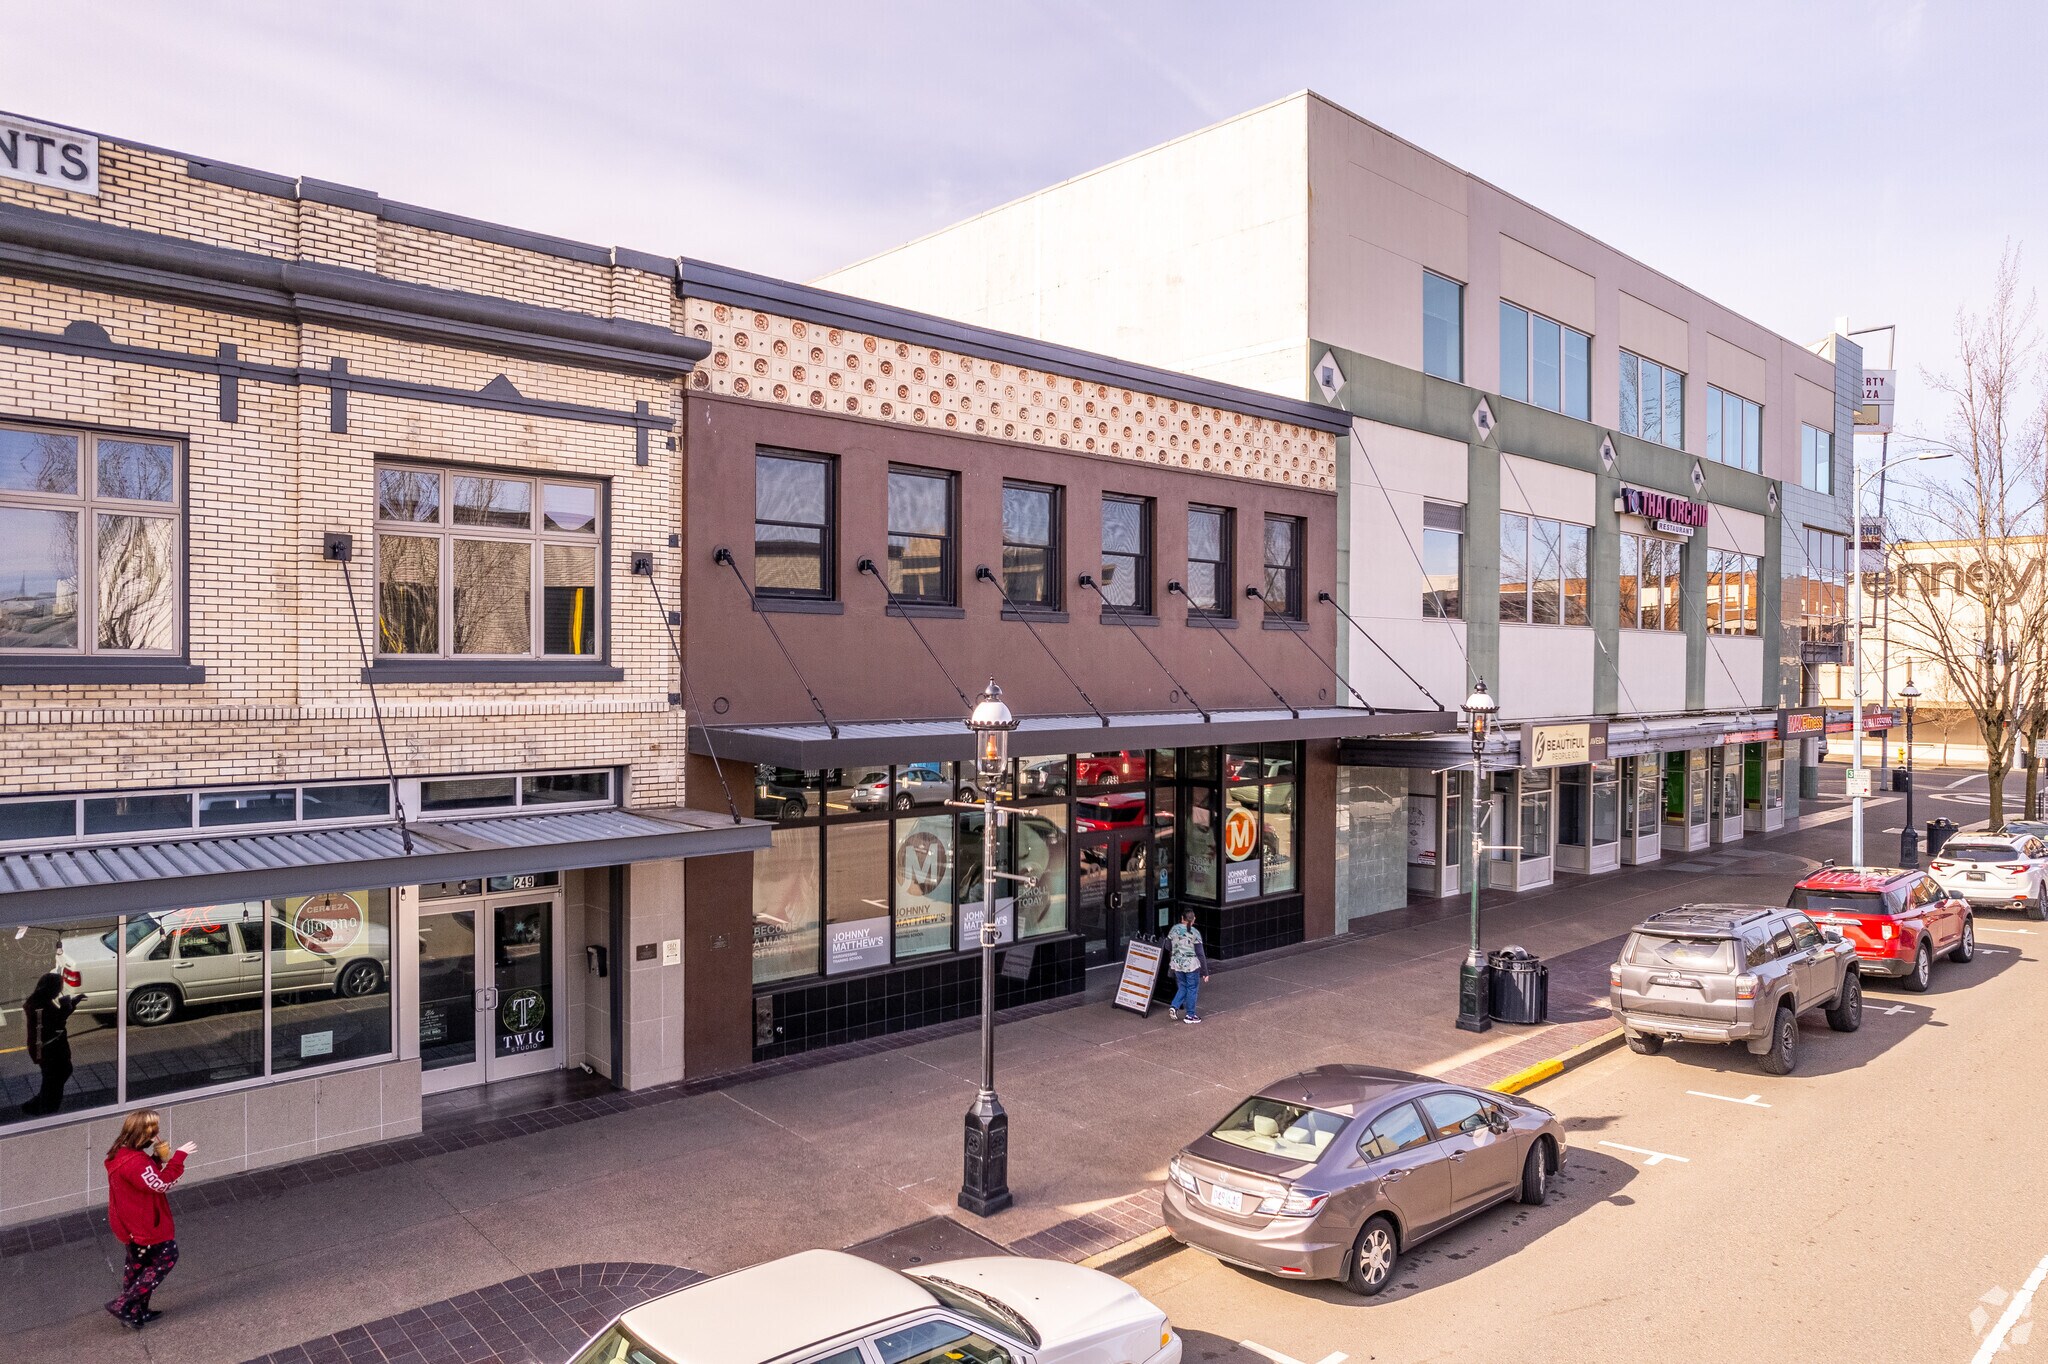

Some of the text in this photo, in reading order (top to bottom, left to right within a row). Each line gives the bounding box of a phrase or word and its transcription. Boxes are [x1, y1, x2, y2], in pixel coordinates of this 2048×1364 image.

[0, 130, 88, 180] NTS
[1862, 377, 1885, 386] RTY
[1642, 491, 1708, 528] THAI ORCHID
[1658, 522, 1693, 535] RESTAURANT
[1847, 558, 2044, 606] enney
[1546, 738, 1585, 751] BEAUTIFUL
[1590, 736, 1606, 745] AVEDA
[1552, 751, 1571, 760] PEOPLE
[1848, 770, 1854, 778] 3
[1228, 868, 1249, 879] JOHNNY
[514, 876, 534, 888] 249
[1227, 874, 1257, 886] MATTHEW'S
[306, 903, 350, 914] CEREZA
[301, 917, 358, 937] Corona
[753, 921, 797, 936] BECOME
[832, 928, 870, 942] JOHNNY
[753, 938, 761, 948] A
[832, 936, 884, 952] MATTHEW'S
[503, 1030, 545, 1049] TWIG
[511, 1043, 538, 1053] STUDIO
